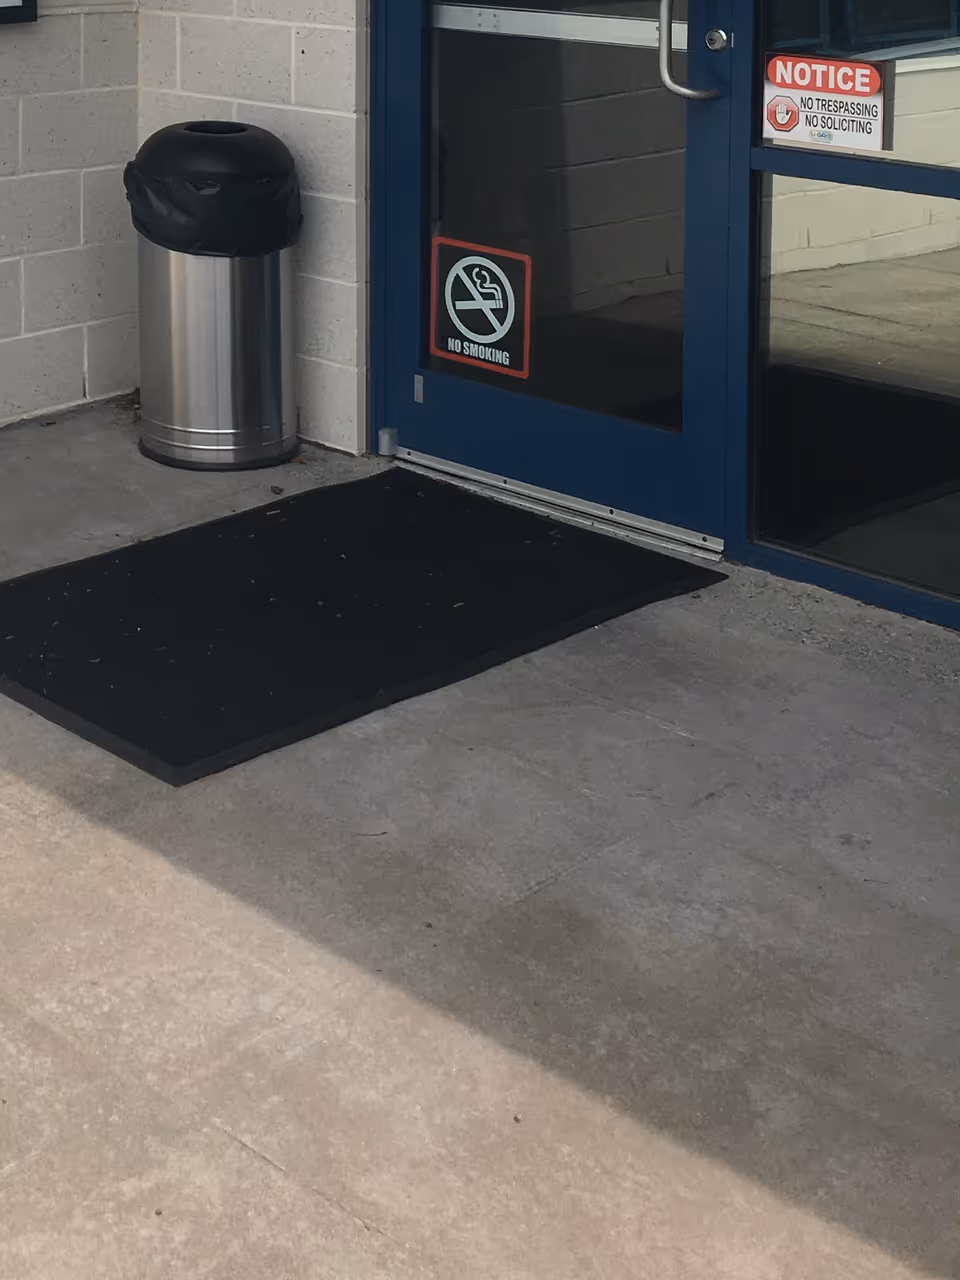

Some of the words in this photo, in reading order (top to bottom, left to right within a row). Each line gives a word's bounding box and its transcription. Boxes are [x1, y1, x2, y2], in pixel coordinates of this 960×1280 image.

[775, 60, 871, 93] NOTICE
[800, 96, 814, 110] NO
[815, 97, 879, 118] TRESPASSING
[805, 114, 819, 128] NO
[820, 116, 873, 135] SOLICITING
[447, 337, 462, 353] NO
[463, 340, 510, 366] SMOKING
